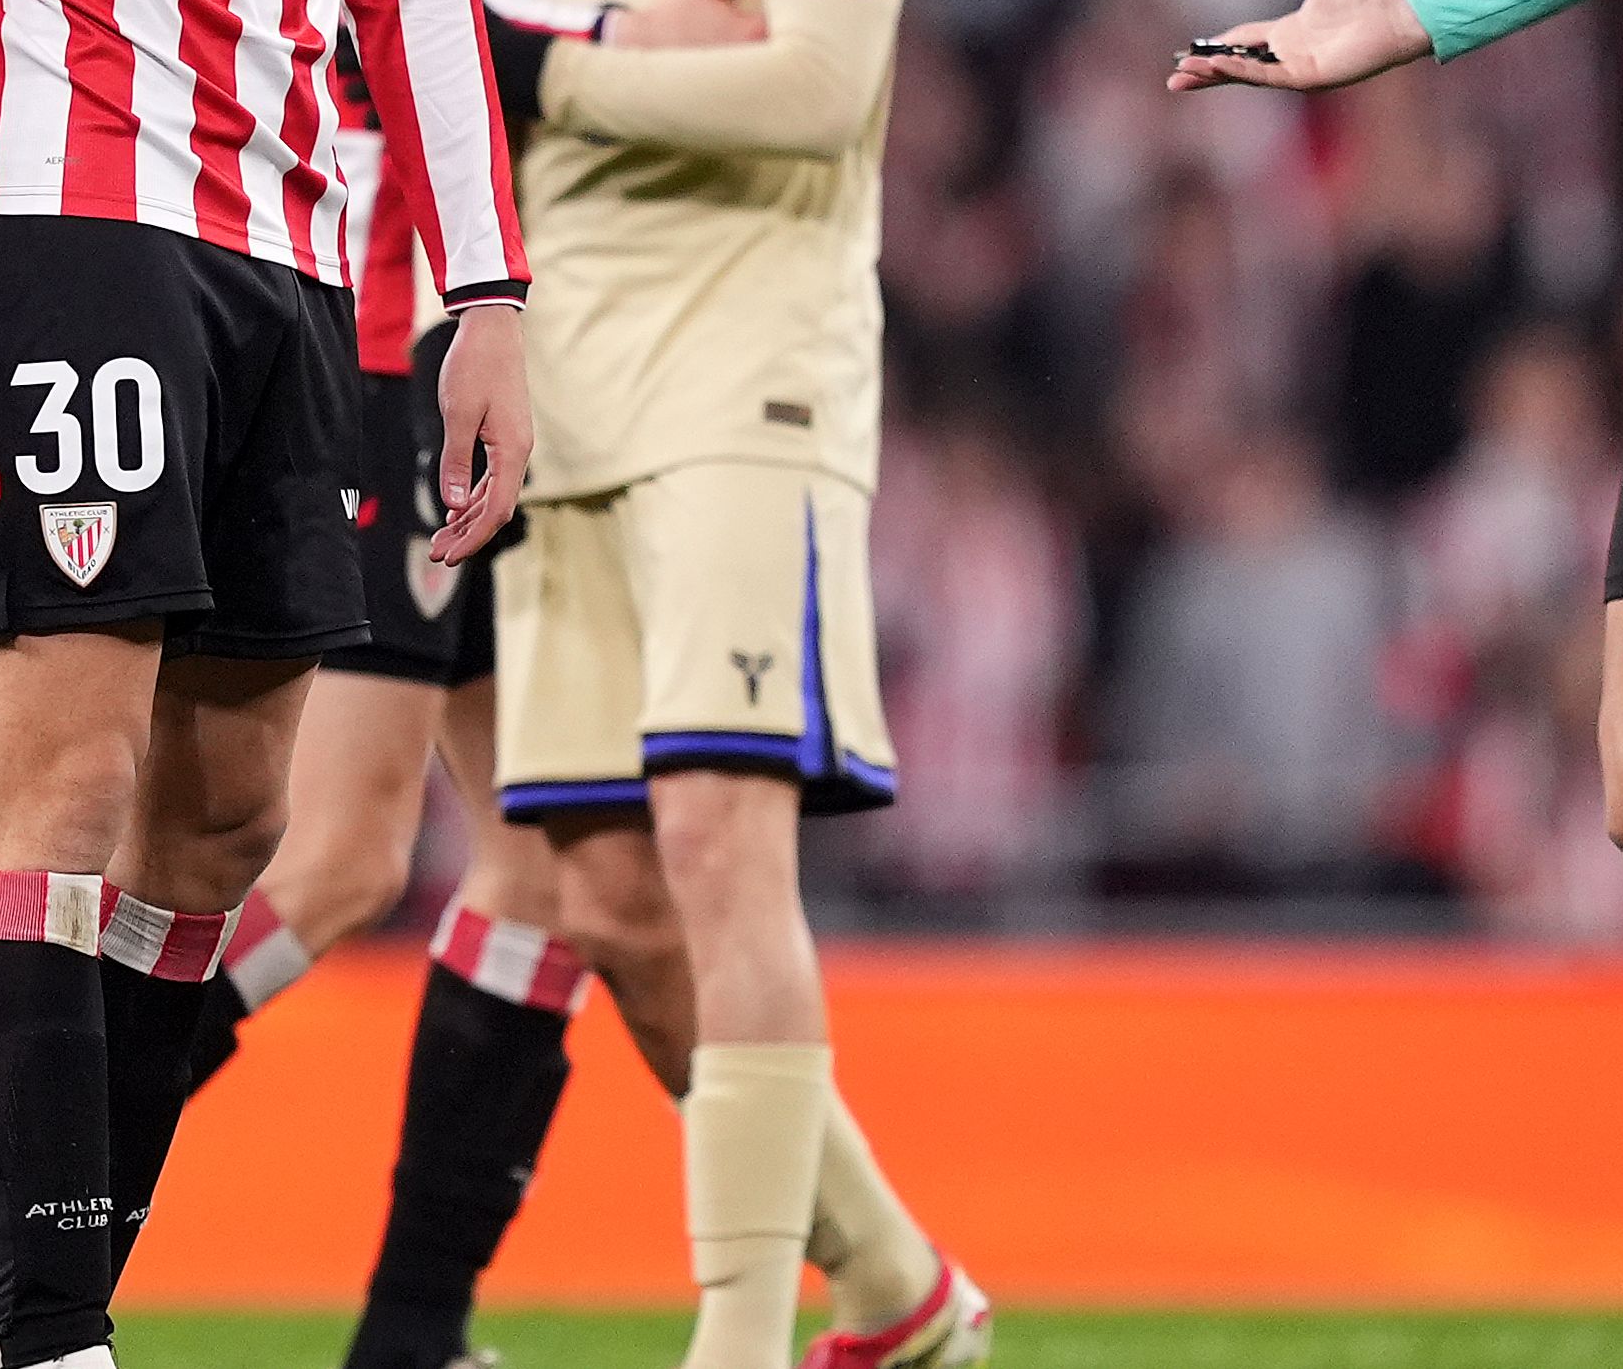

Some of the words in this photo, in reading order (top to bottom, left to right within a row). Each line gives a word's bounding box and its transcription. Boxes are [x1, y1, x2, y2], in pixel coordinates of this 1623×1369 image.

[10, 357, 165, 494] 30
[86, 509, 108, 517] CLUB
[67, 559, 96, 580] BILBAO
[57, 1214, 108, 1230] CLUB
